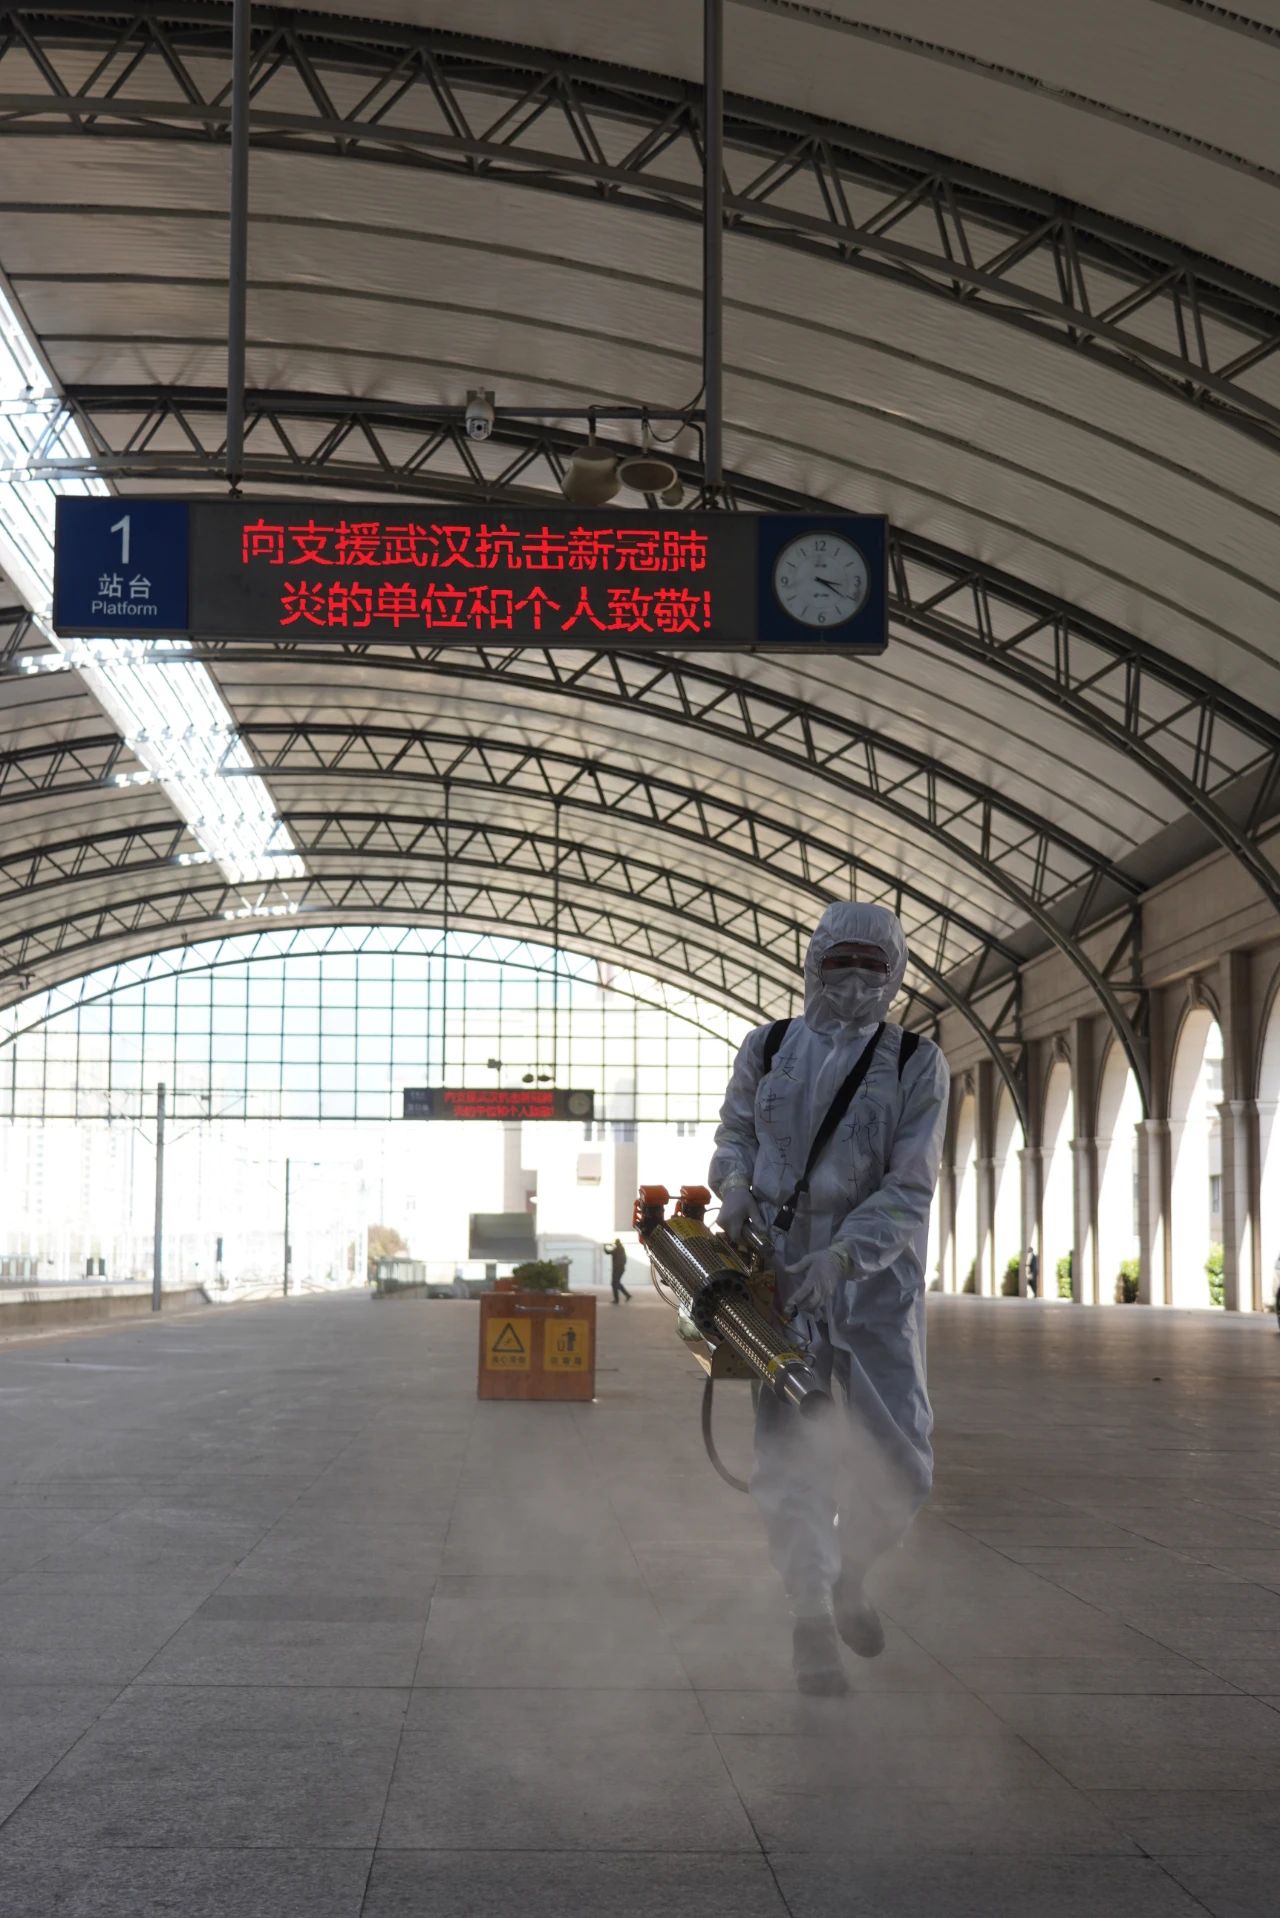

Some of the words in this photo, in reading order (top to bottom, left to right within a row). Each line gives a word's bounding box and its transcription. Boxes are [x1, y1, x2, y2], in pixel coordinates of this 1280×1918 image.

[110, 514, 131, 565] 1
[242, 518, 709, 572] 向支援武汉抗击新冠肺
[814, 540, 828, 552] 12
[97, 572, 153, 599] 站台
[780, 576, 790, 588] 9
[853, 575, 863, 588] 3
[91, 600, 158, 616] Platform
[817, 612, 827, 624] 6
